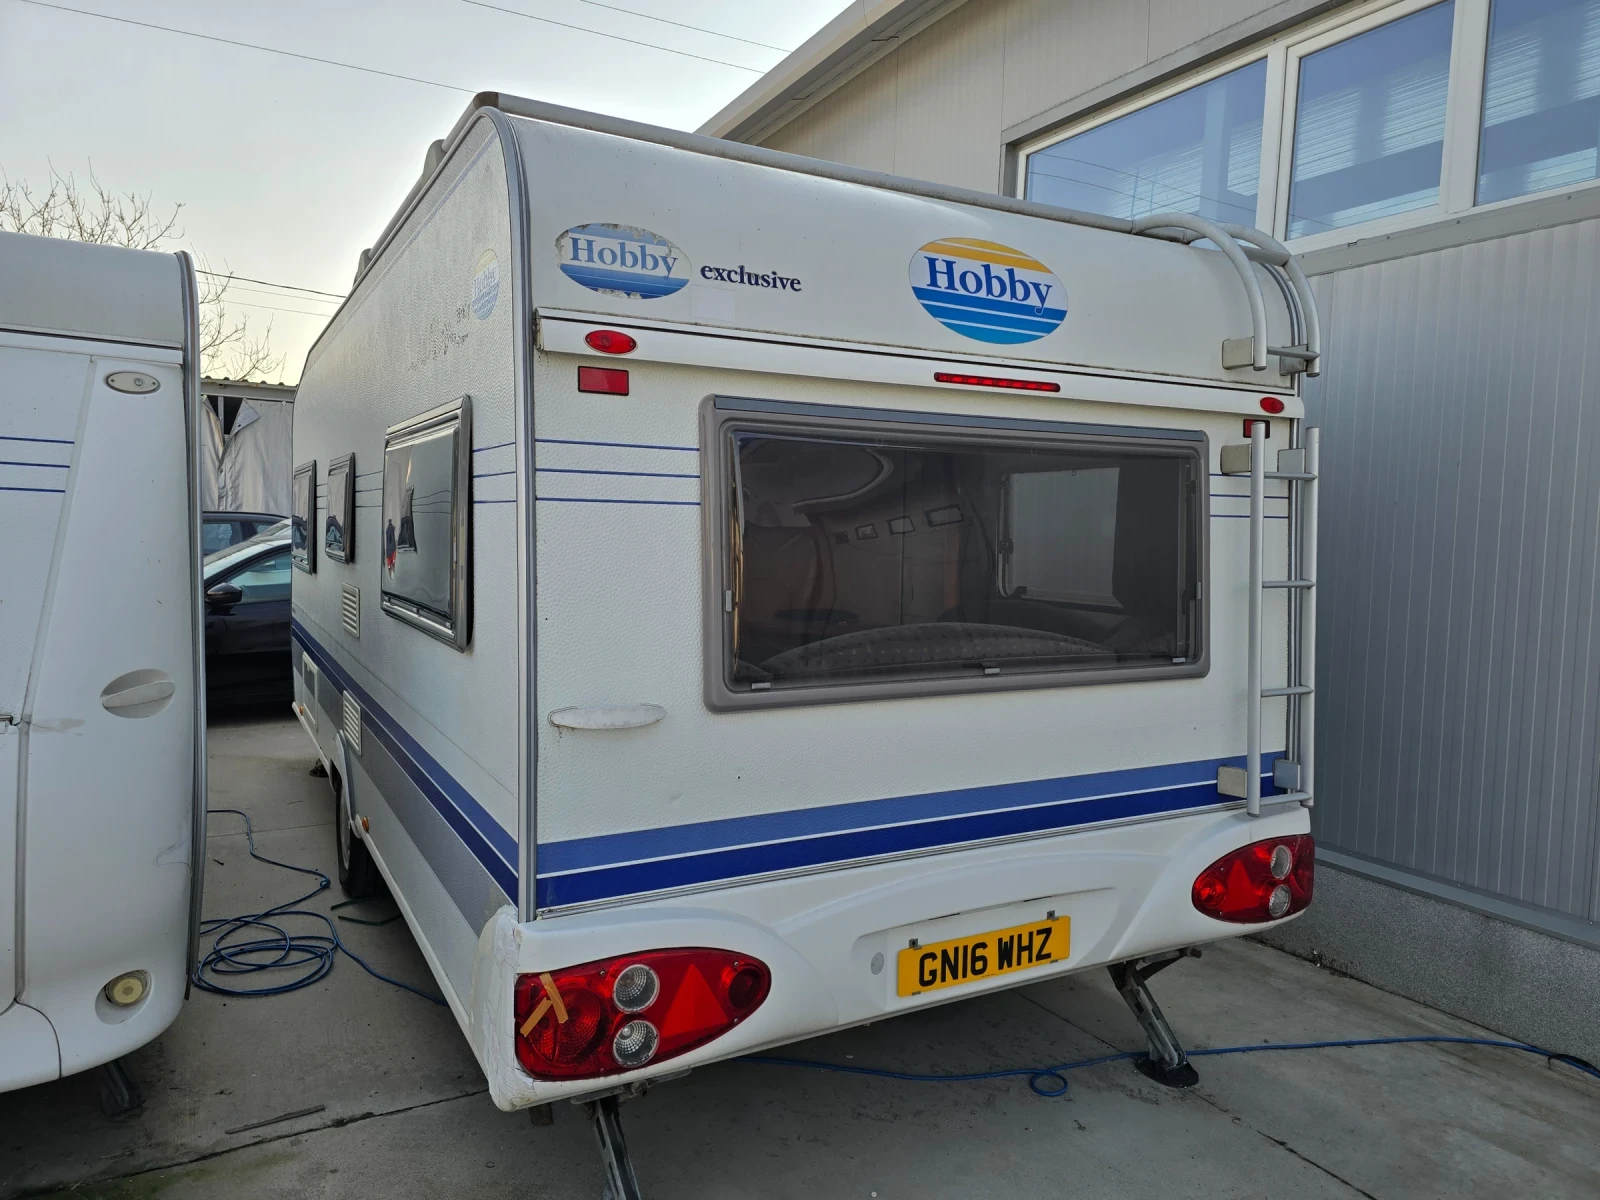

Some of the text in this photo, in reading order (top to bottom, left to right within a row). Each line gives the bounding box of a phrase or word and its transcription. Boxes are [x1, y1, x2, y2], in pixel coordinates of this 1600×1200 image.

[568, 236, 802, 292] Hobby exclusive
[923, 255, 1053, 315] Hobby
[918, 926, 1053, 988] GN16 WHZ
